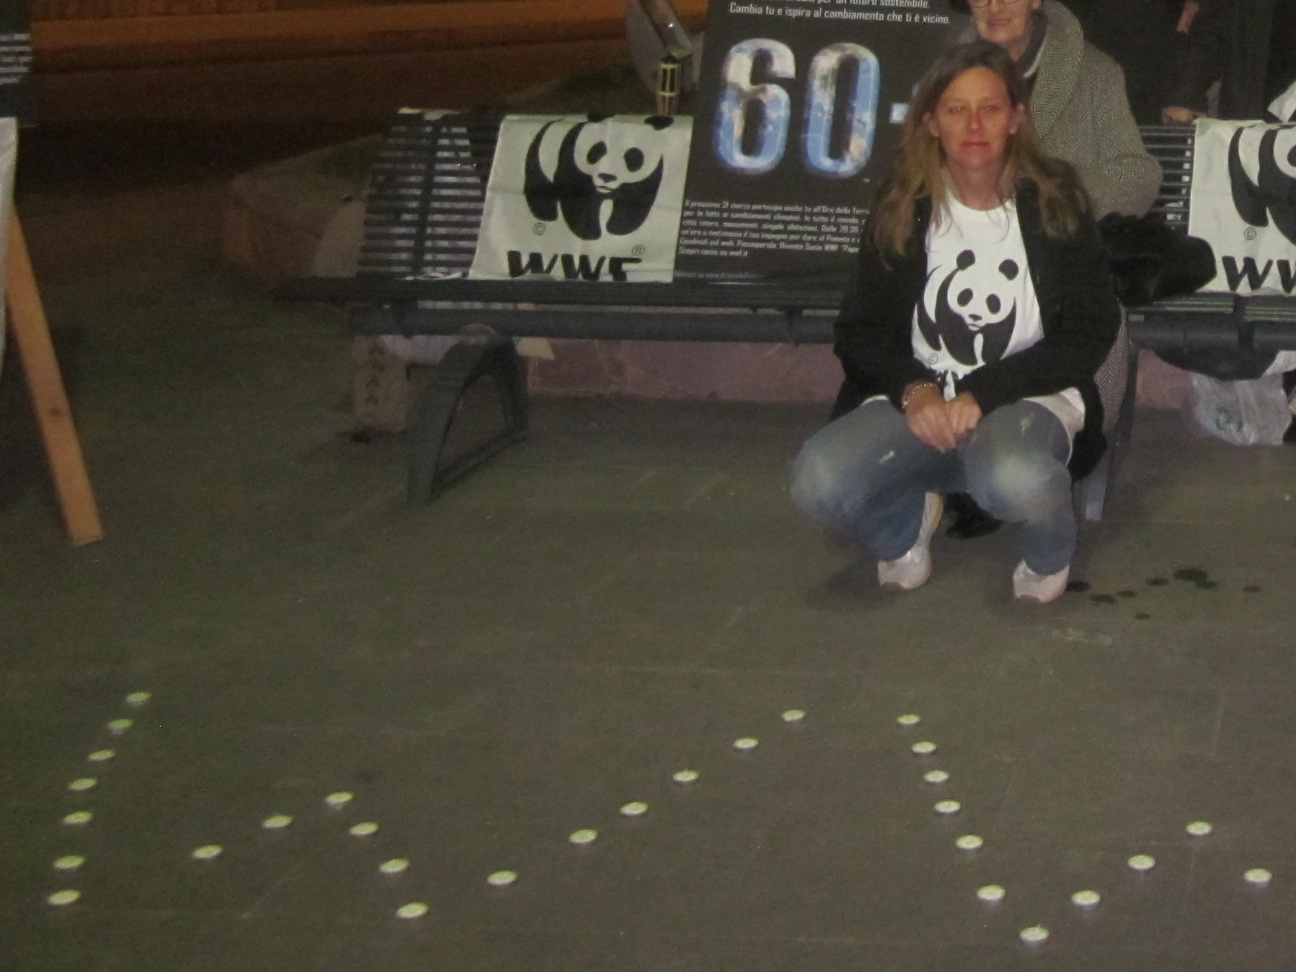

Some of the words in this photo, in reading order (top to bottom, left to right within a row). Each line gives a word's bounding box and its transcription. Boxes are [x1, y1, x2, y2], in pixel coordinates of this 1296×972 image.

[730, 1, 762, 14] Cambia
[765, 5, 774, 15] tu
[777, 7, 782, 15] e
[785, 6, 810, 18] ispira
[814, 7, 821, 17] al
[824, 7, 883, 20] cambiamento
[887, 11, 902, 21] che
[905, 12, 911, 22] ti
[914, 12, 919, 22] è
[922, 14, 950, 24] vicino.
[507, 250, 642, 282] WWF
